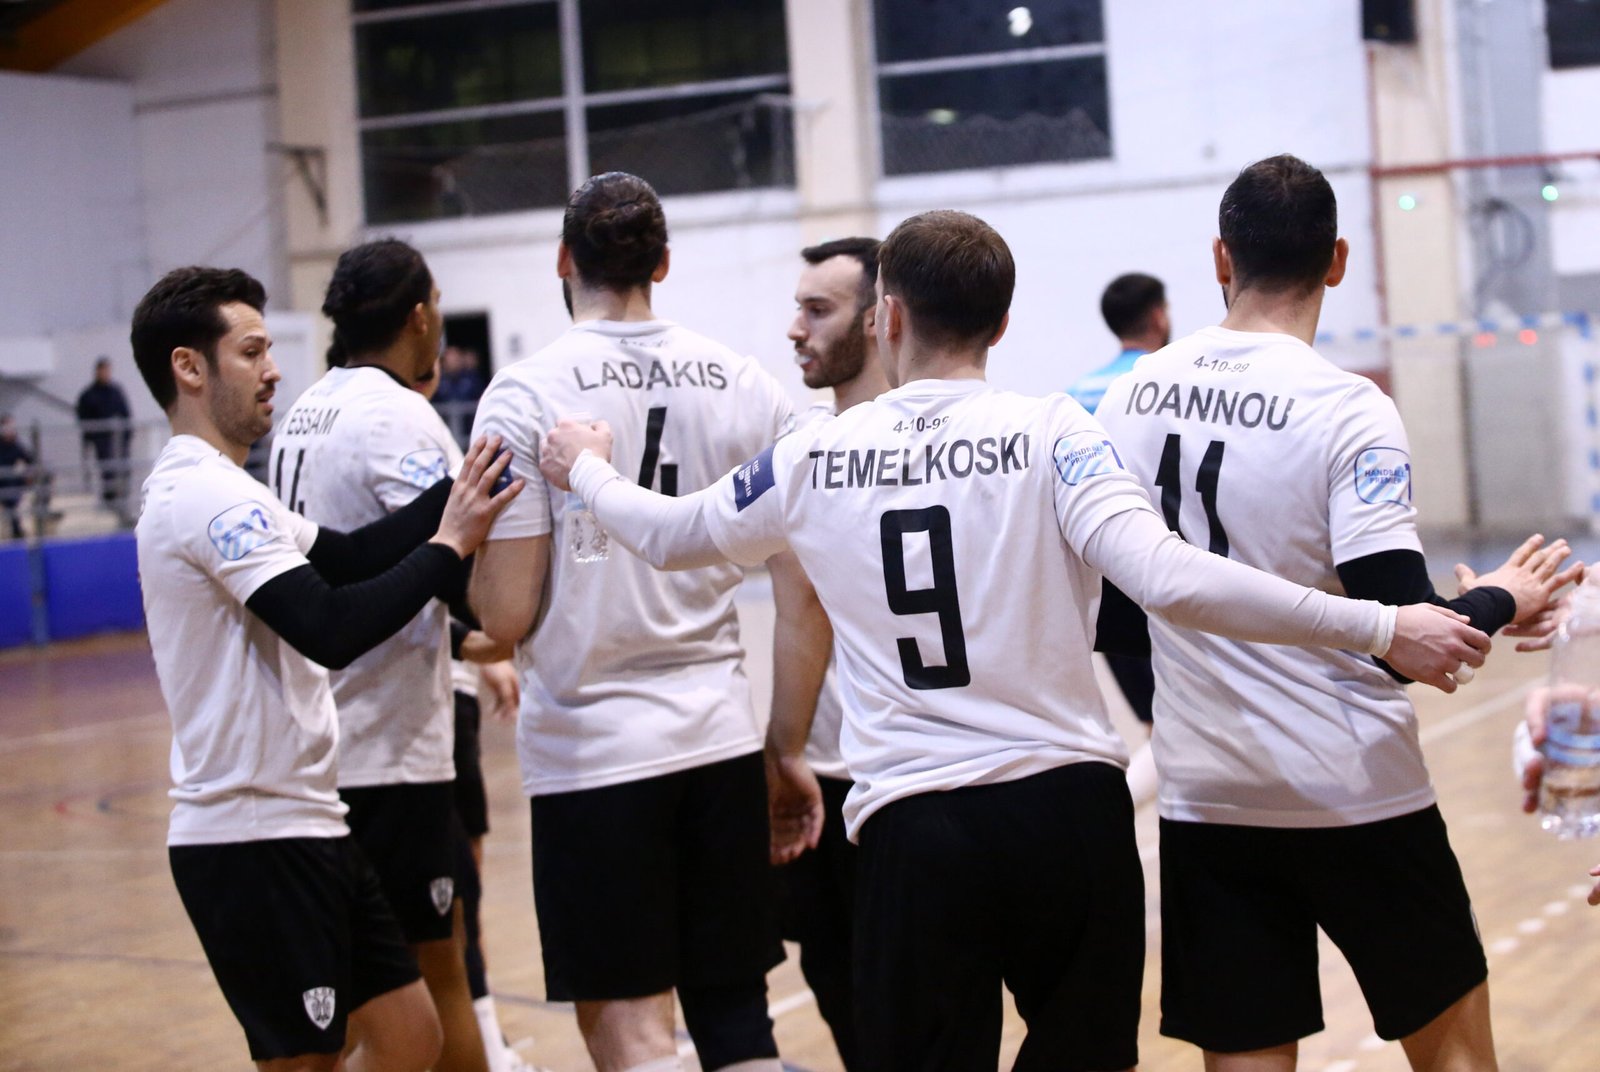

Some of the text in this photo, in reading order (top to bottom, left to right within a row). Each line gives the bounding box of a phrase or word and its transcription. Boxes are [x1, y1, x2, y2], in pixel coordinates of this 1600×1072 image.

[573, 360, 728, 391] LADAKIS
[1194, 356, 1250, 373] 4-10-99
[287, 408, 341, 435] ESSAM
[1125, 381, 1295, 431] IOANNOU
[808, 432, 1030, 489] TEMELKOSKI
[1154, 433, 1230, 558] 11
[880, 504, 971, 690] 9
